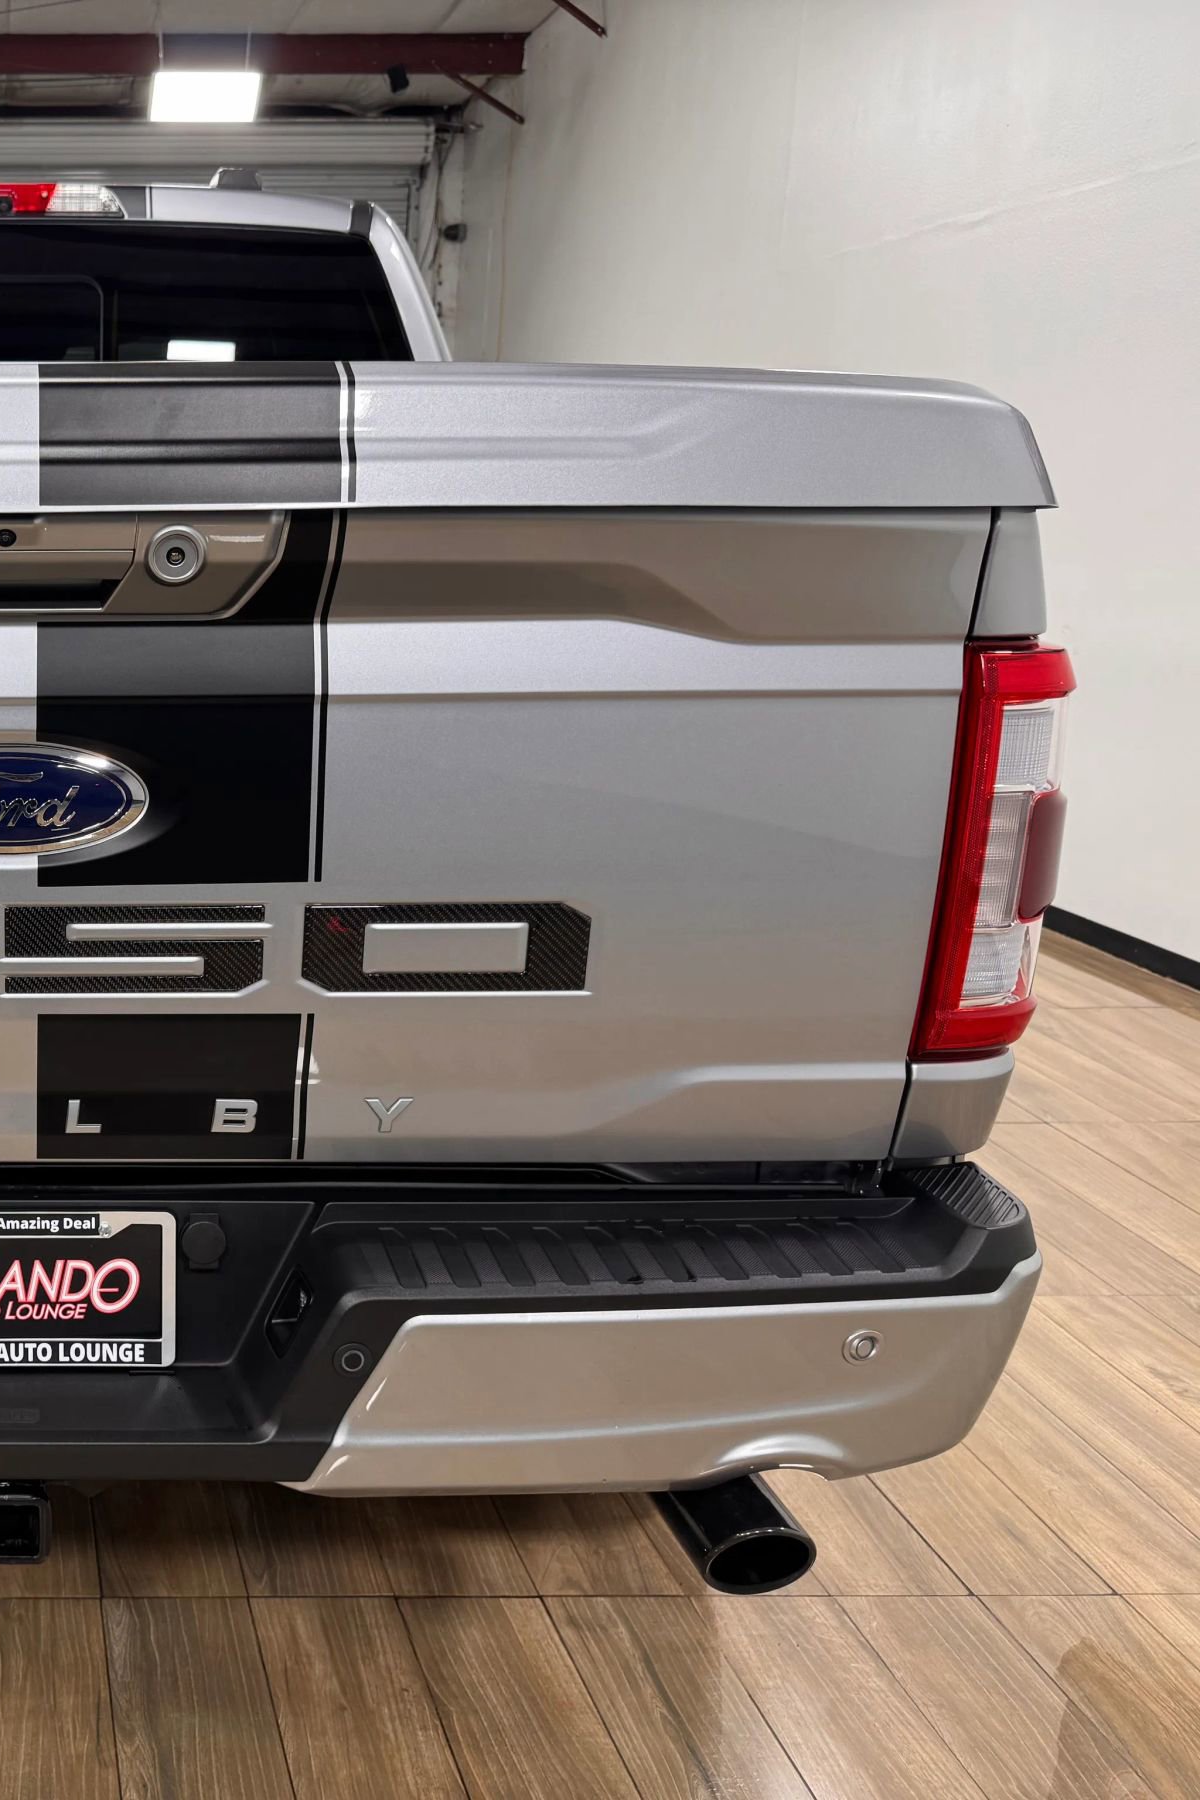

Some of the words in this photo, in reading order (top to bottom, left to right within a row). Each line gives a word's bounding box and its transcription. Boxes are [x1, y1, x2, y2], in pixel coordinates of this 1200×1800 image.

[63, 1216, 96, 1230] Deal
[4, 1301, 88, 1320] LOUNGE
[58, 1342, 145, 1363] LOUNGE
